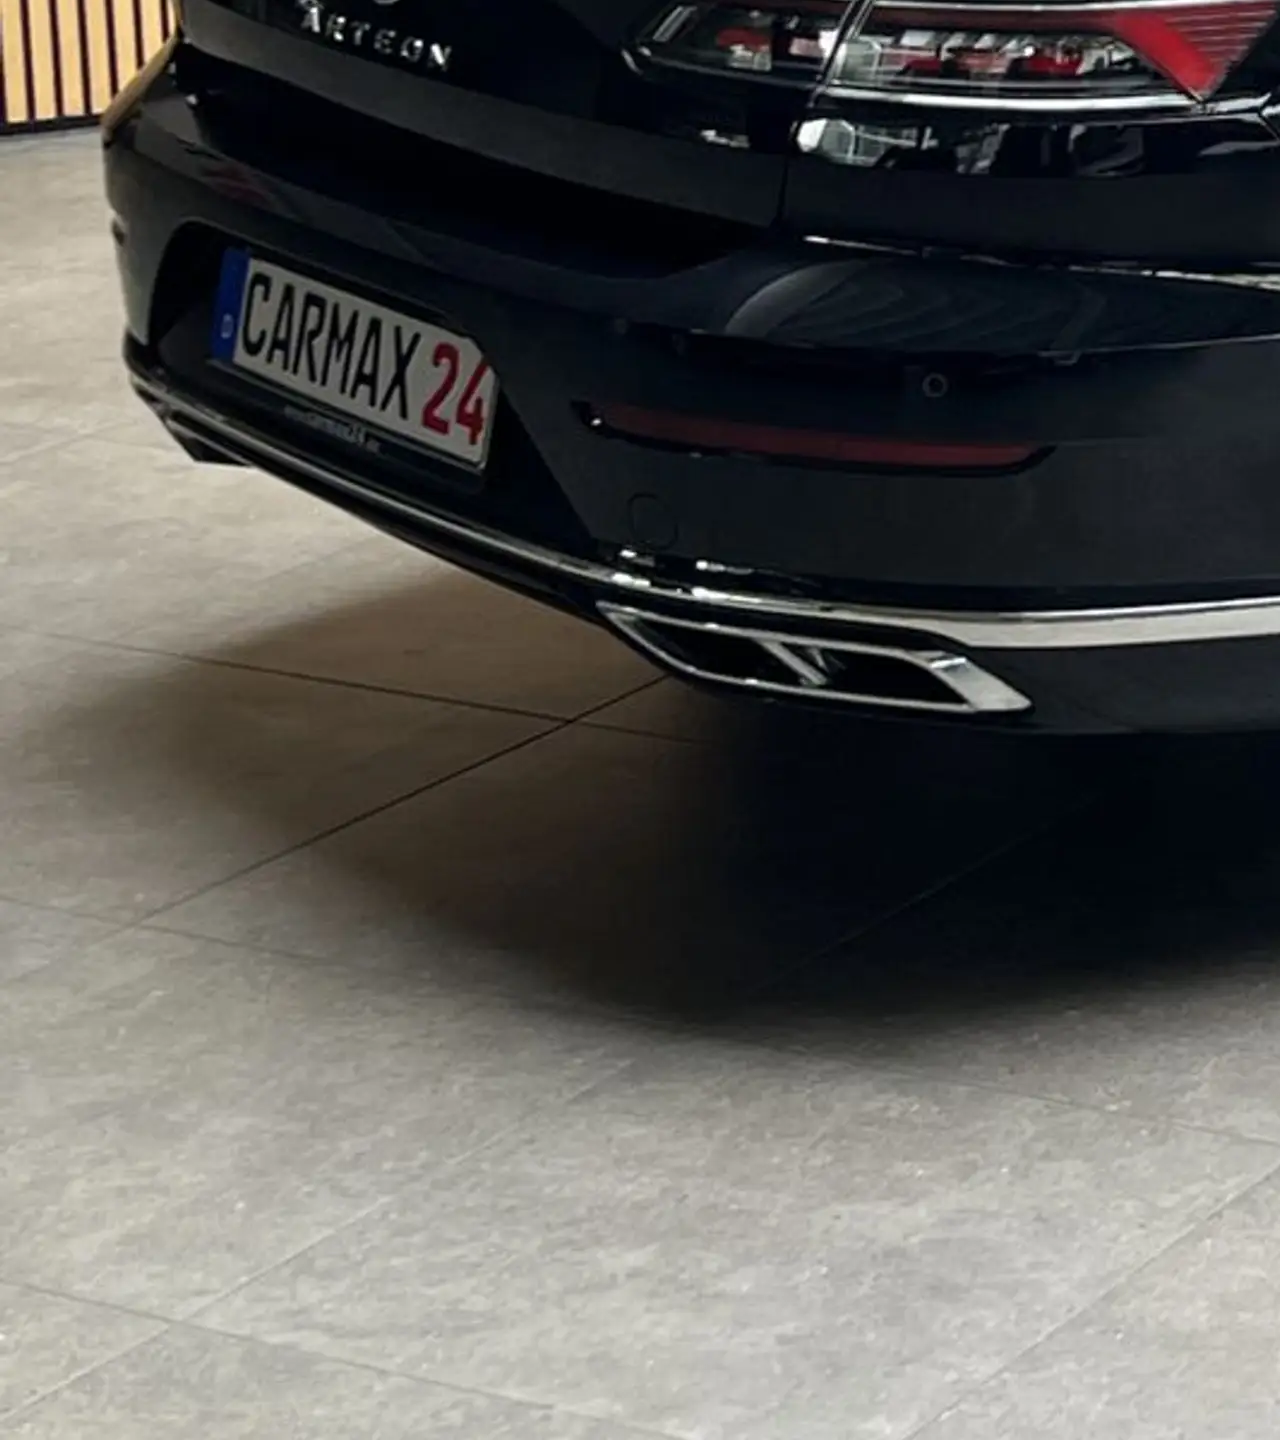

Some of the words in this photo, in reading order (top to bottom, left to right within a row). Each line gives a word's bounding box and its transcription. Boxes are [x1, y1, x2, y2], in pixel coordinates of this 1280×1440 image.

[300, 5, 453, 73] ARTEON
[241, 272, 421, 420] CARMAX
[422, 342, 490, 445] 24
